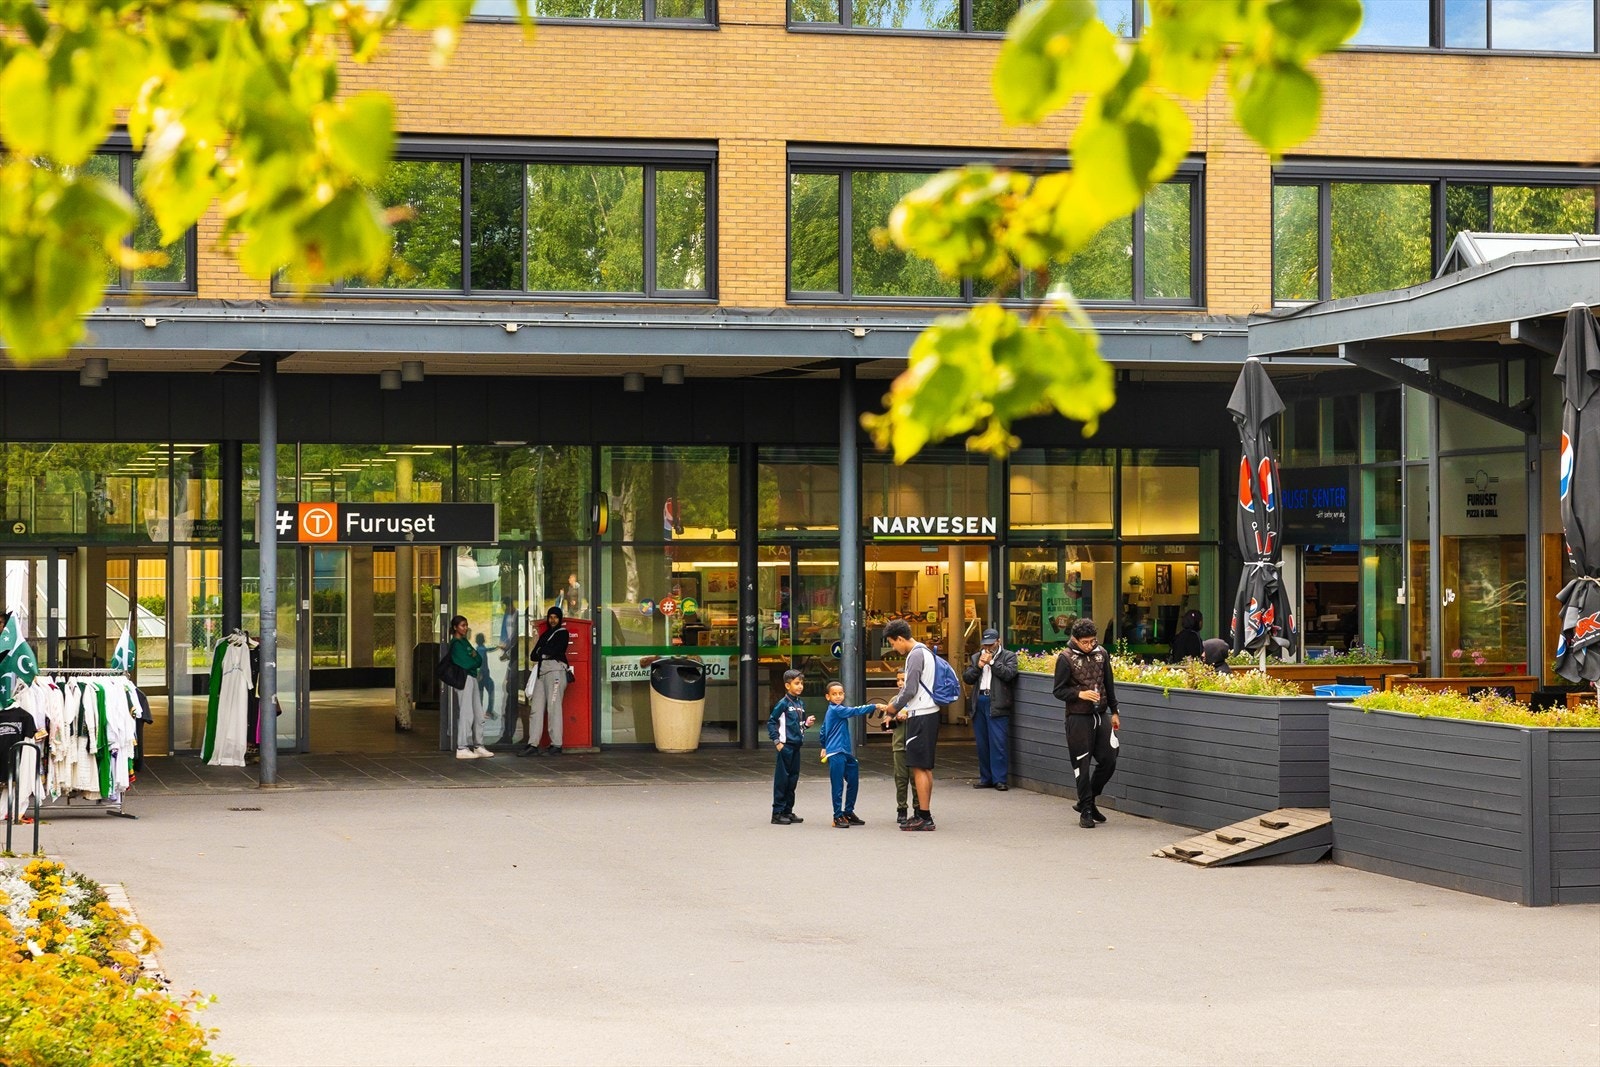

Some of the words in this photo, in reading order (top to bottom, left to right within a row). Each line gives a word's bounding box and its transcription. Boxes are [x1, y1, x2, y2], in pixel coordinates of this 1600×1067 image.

[1312, 487, 1346, 508] SENTER
[1467, 493, 1498, 506] FURUSET
[346, 512, 436, 533] Furuset
[873, 516, 997, 534] NARVESEN
[610, 663, 633, 671] KAFFE
[633, 663, 639, 671] &
[610, 669, 650, 678] BAKERVARE
